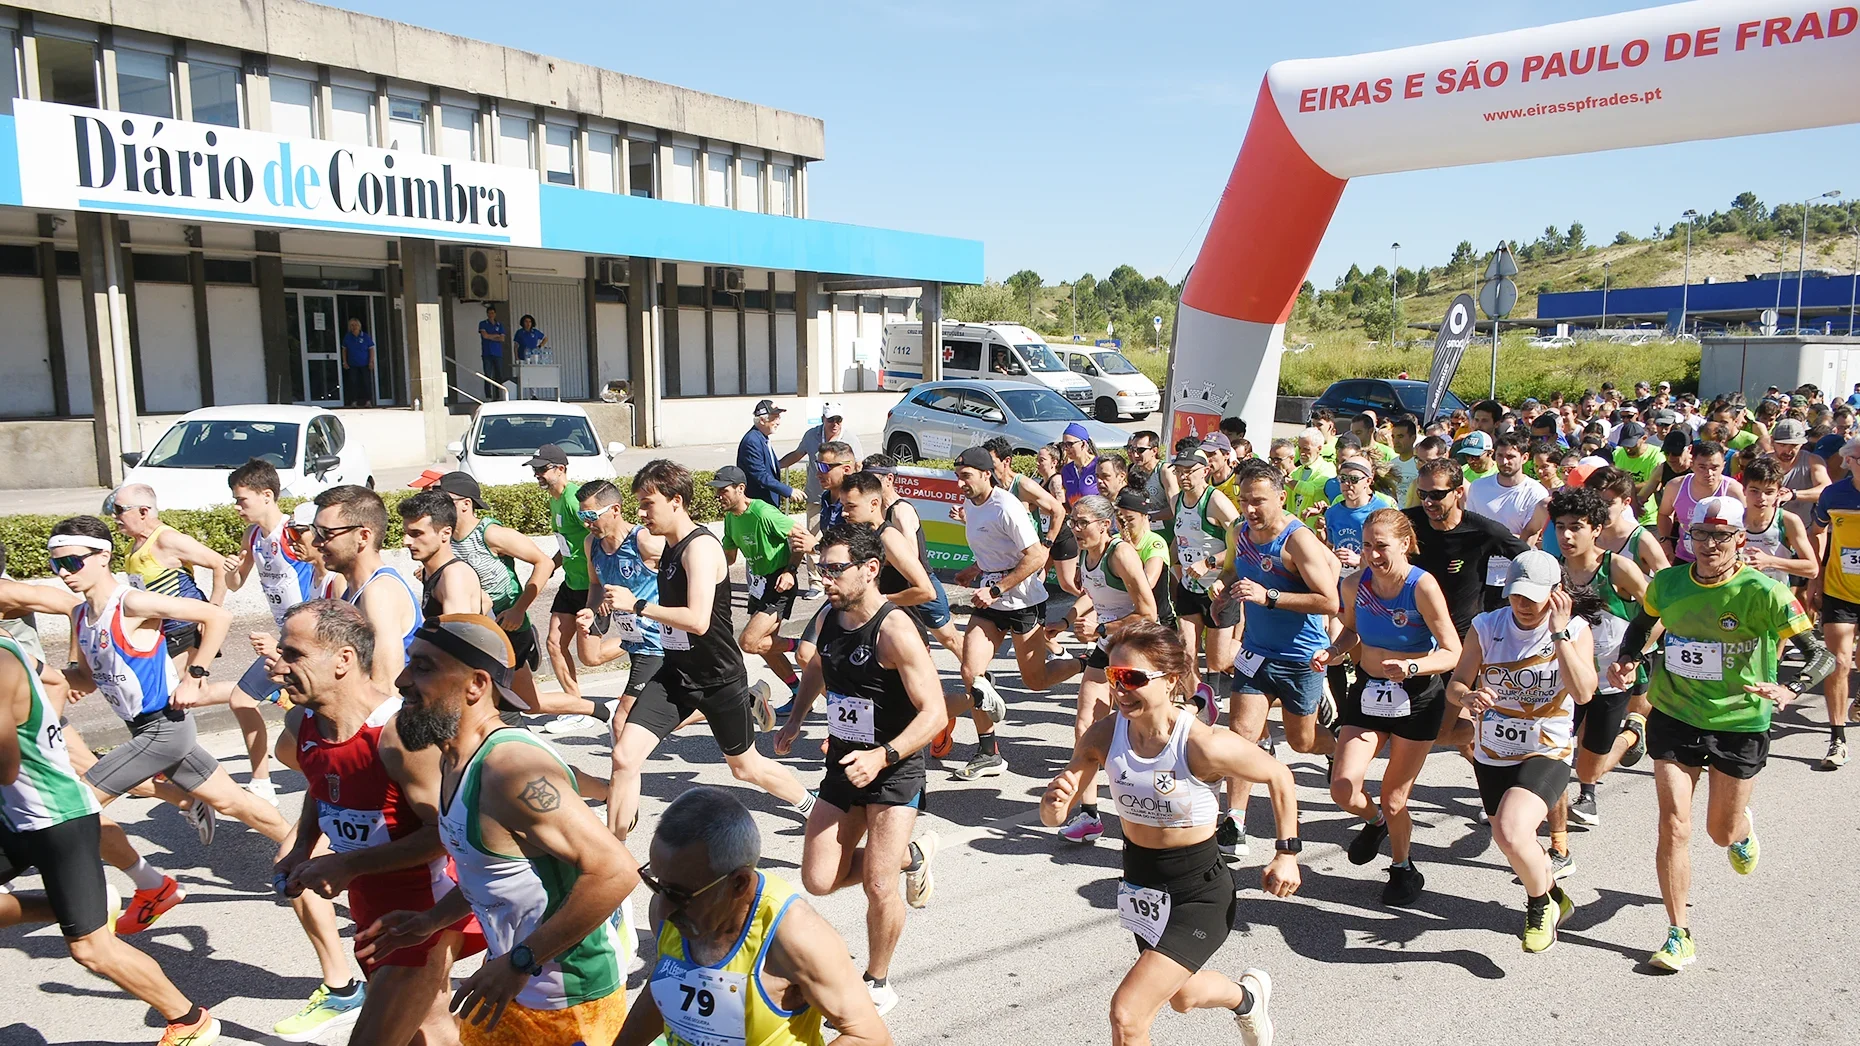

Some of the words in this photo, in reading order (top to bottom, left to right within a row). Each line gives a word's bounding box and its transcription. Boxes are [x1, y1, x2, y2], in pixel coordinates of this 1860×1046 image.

[1299, 77, 1394, 113] EIRAS
[1403, 72, 1426, 99] E
[1435, 59, 1509, 95] SÃO
[1521, 38, 1651, 83] PAULO
[1664, 26, 1721, 62] DE
[1735, 6, 1859, 51] FRAD
[1483, 87, 1662, 122] www.eirasspfrades.pt
[69, 114, 254, 204] Diário
[263, 141, 321, 211] de
[328, 149, 509, 228] Coimbra
[897, 346, 911, 355] 112
[913, 489, 943, 499] PAULO
[945, 492, 957, 501] DE
[925, 549, 950, 560] RTO
[953, 553, 969, 562] DE
[1183, 553, 1194, 563] 12
[1681, 649, 1704, 665] 83
[1376, 689, 1393, 703] 71
[838, 706, 858, 724] 24
[1494, 723, 1527, 743] 501
[333, 819, 370, 842] 107
[1130, 897, 1160, 922] 193
[679, 984, 715, 1017] 79
